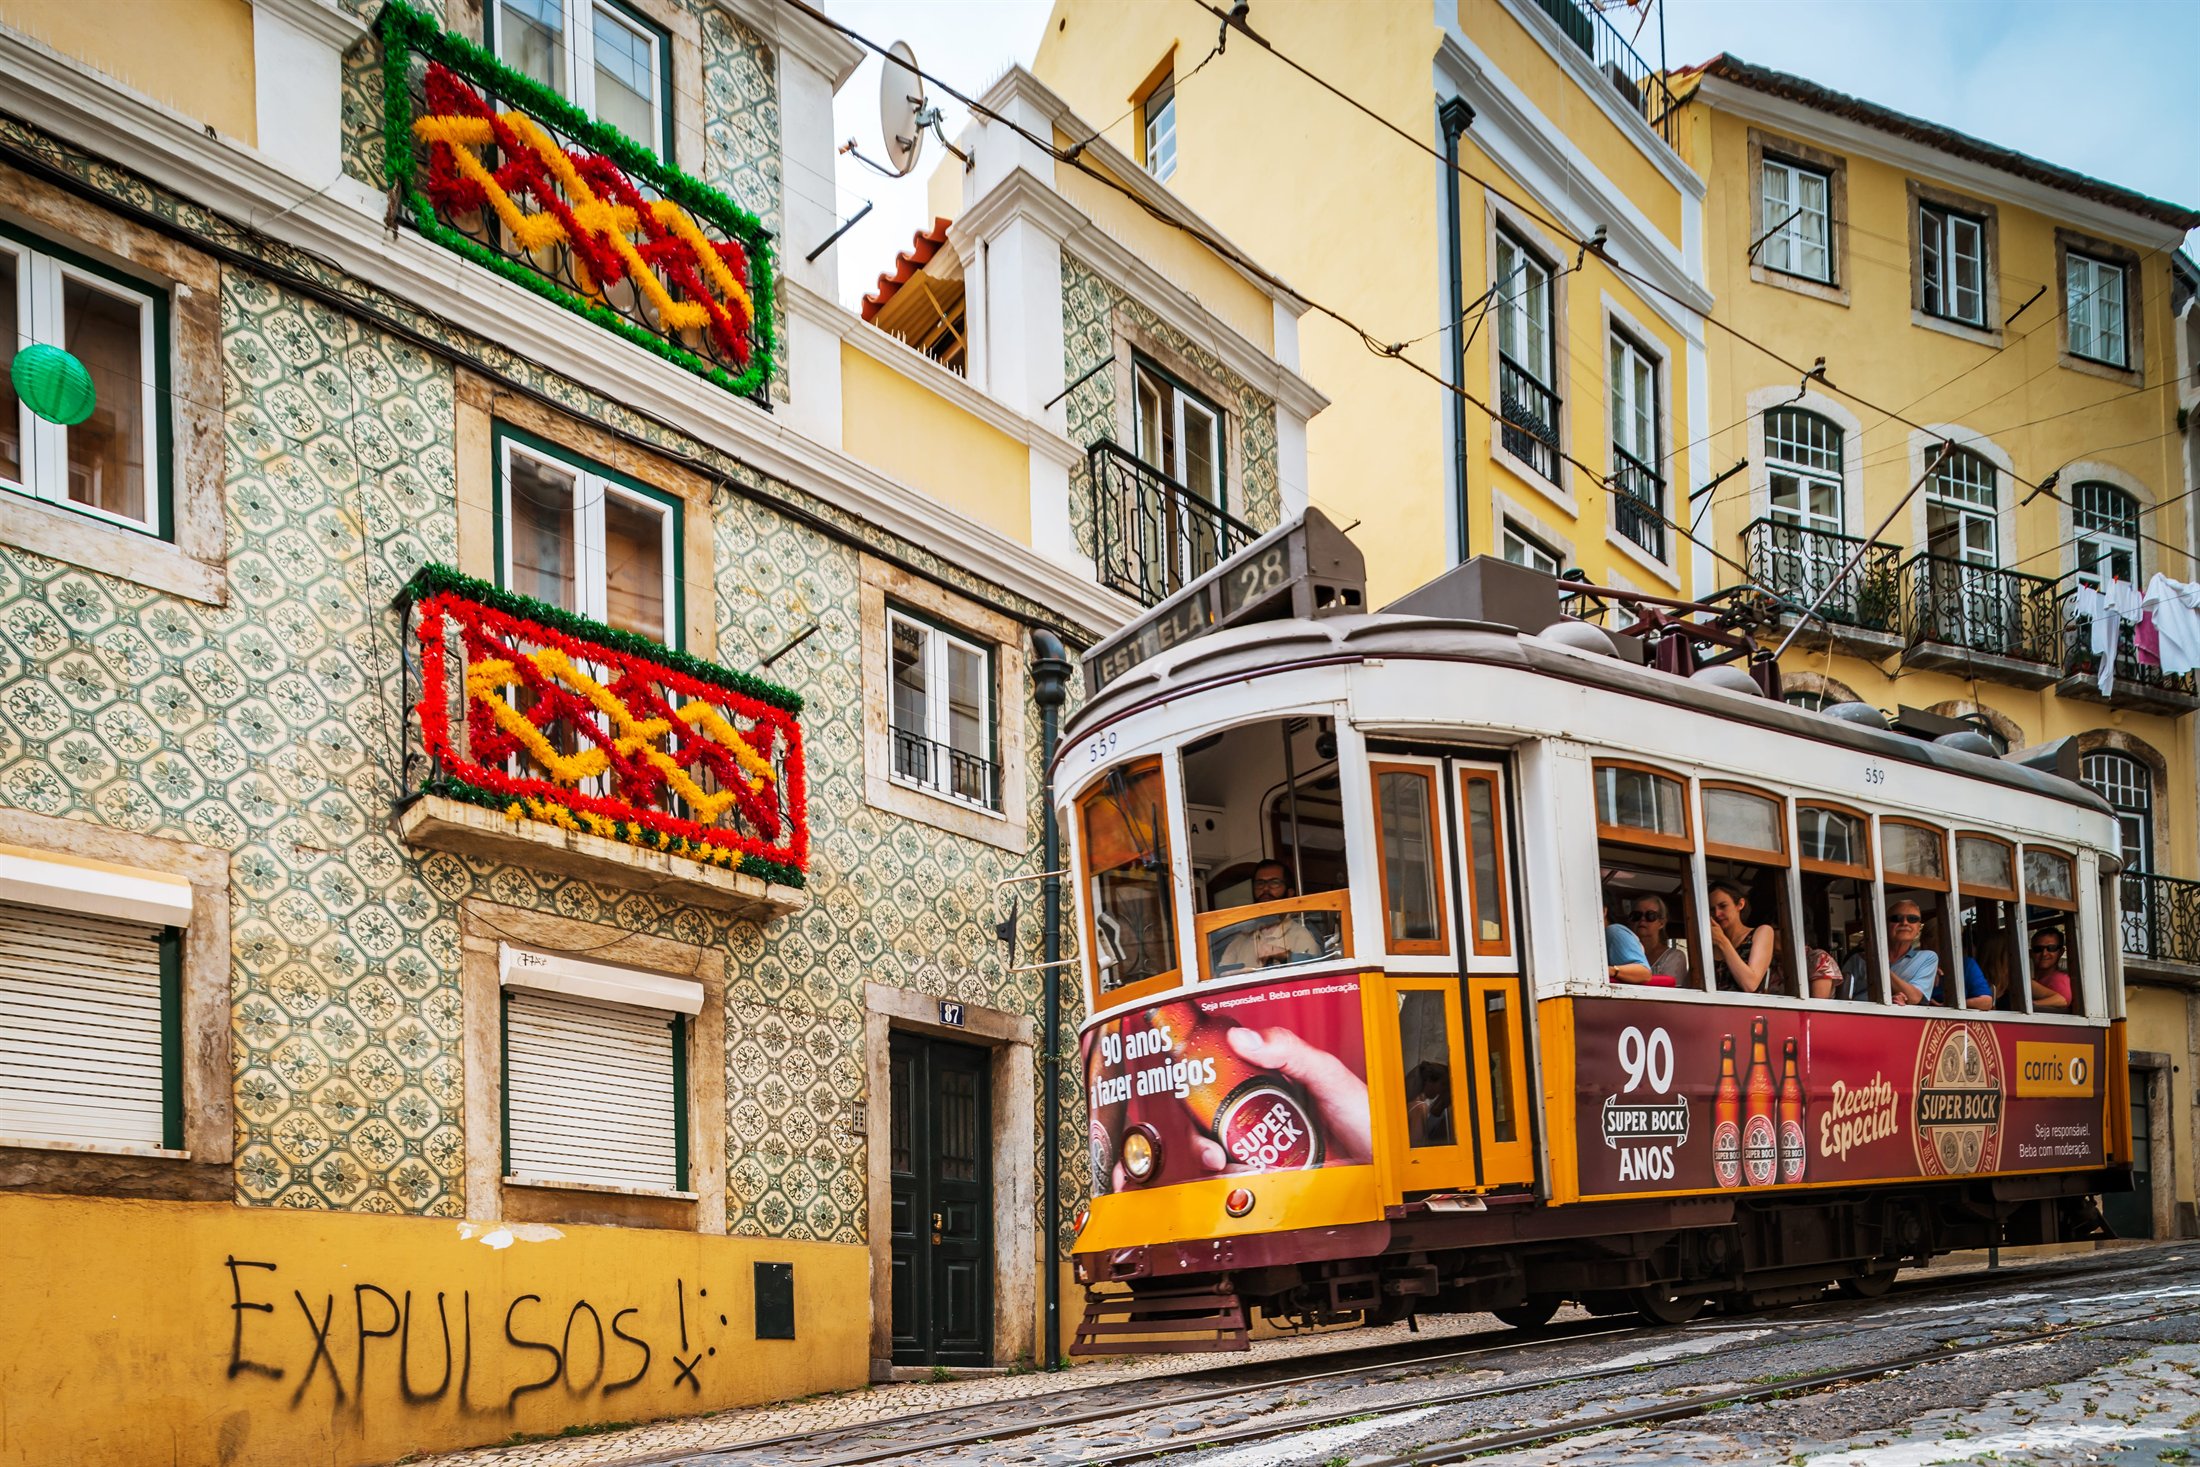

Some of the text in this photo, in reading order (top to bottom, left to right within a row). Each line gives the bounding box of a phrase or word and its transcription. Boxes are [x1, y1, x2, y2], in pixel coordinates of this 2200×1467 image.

[1241, 548, 1284, 607] 28
[1090, 732, 1117, 763] 559
[1865, 767, 1885, 785] 559
[1201, 982, 1361, 1012] Seja responsável. Beba com moderação.
[944, 1003, 959, 1024] 87
[1101, 1025, 1173, 1067] 90 anos
[1617, 1026, 1674, 1095] 90
[1097, 1074, 1132, 1107] fazer
[1136, 1056, 1217, 1099] amigos
[2024, 1054, 2063, 1081] carris
[1831, 1070, 1892, 1121] Receita
[1921, 1094, 1997, 1120] SUPER BOCK
[1231, 1102, 1291, 1161] SUPER
[1607, 1110, 1685, 1132] SUPER BOCK
[1820, 1090, 1899, 1162] Especial
[2035, 1123, 2091, 1141] Seja responsável.
[1246, 1118, 1303, 1173] BOCK
[1745, 1148, 1775, 1159] SUPER BOCK
[2019, 1141, 2092, 1159] Beba com moderação.
[1618, 1145, 1675, 1182] ANOS
